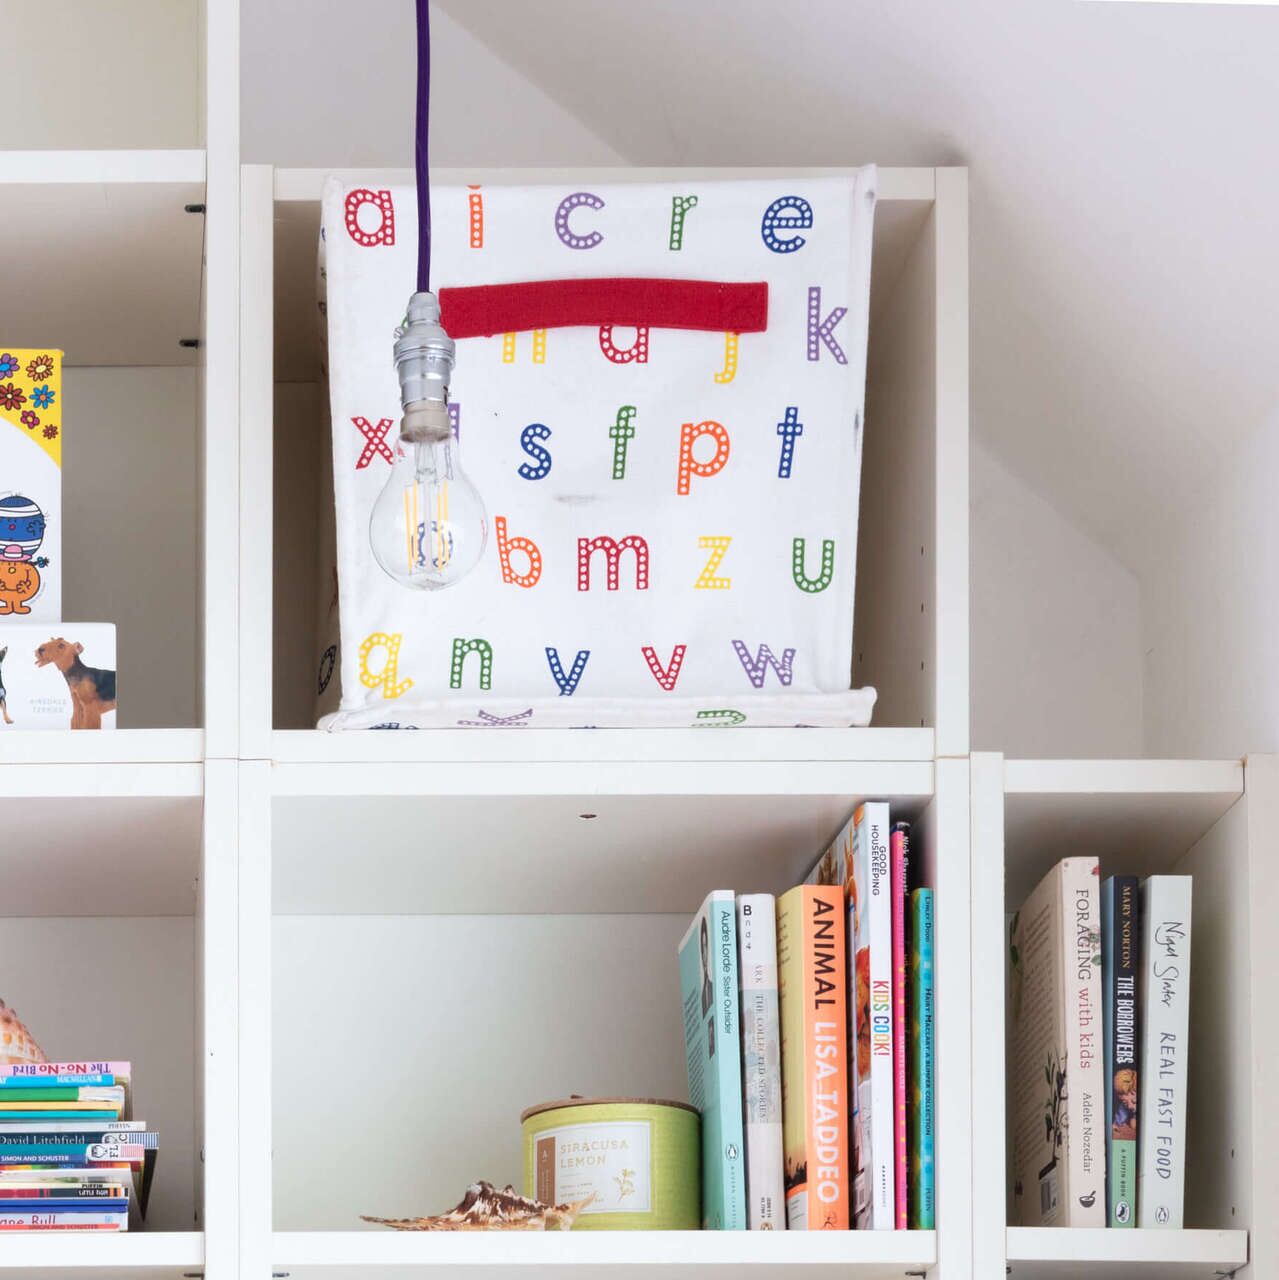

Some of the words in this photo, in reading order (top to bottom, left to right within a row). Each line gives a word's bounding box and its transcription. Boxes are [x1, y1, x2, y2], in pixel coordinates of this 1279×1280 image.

[555, 191, 605, 249] c
[670, 195, 699, 251] r
[760, 195, 814, 253] e
[577, 535, 649, 592] m
[871, 824, 881, 896] HOUSEKEEPING
[878, 846, 887, 876] GOOD
[1121, 886, 1132, 918] MARY
[721, 911, 733, 942] Audre
[1075, 889, 1091, 980] FORAGING
[1121, 920, 1132, 968] NORTON
[722, 943, 733, 973] Lorde
[813, 897, 836, 1010] ANIMAL
[722, 976, 732, 997] Sister
[873, 980, 890, 1012] KIDS
[1078, 988, 1092, 1026] with
[1117, 976, 1134, 998] THE
[723, 998, 733, 1034] Outsider
[873, 1015, 891, 1057] COOK!
[1115, 1000, 1135, 1064] BORROWERS
[814, 1021, 838, 1078] LISA
[1079, 1032, 1093, 1069] kids
[1159, 1032, 1176, 1079] REAL
[1157, 1088, 1174, 1127] FAST
[815, 1088, 840, 1204] TADDEO
[1156, 1136, 1172, 1179] FOOD
